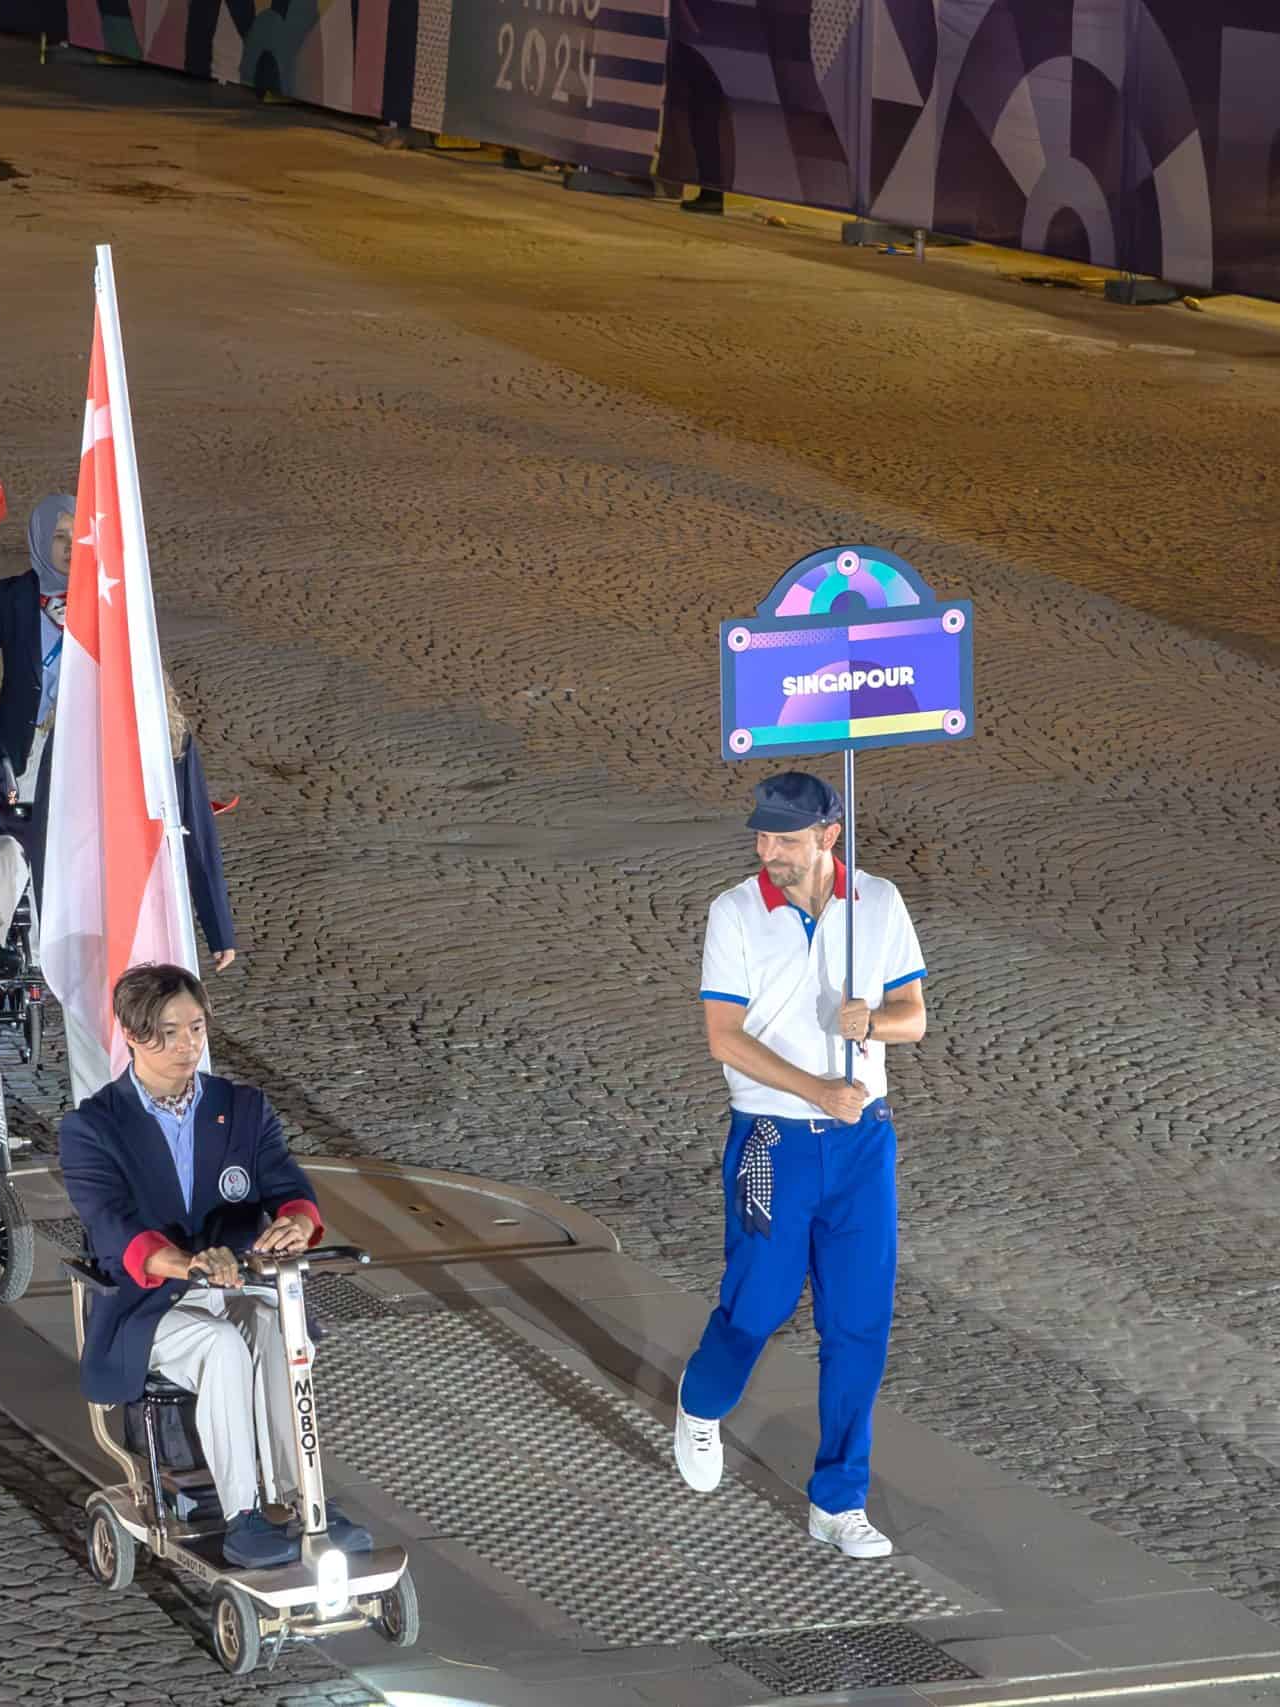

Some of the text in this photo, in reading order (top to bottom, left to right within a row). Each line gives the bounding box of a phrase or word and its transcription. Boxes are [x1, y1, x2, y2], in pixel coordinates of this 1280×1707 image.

[496, 22, 596, 108] 2024
[782, 666, 915, 702] SINGAPOUR
[294, 1378, 317, 1469] MOBOT
